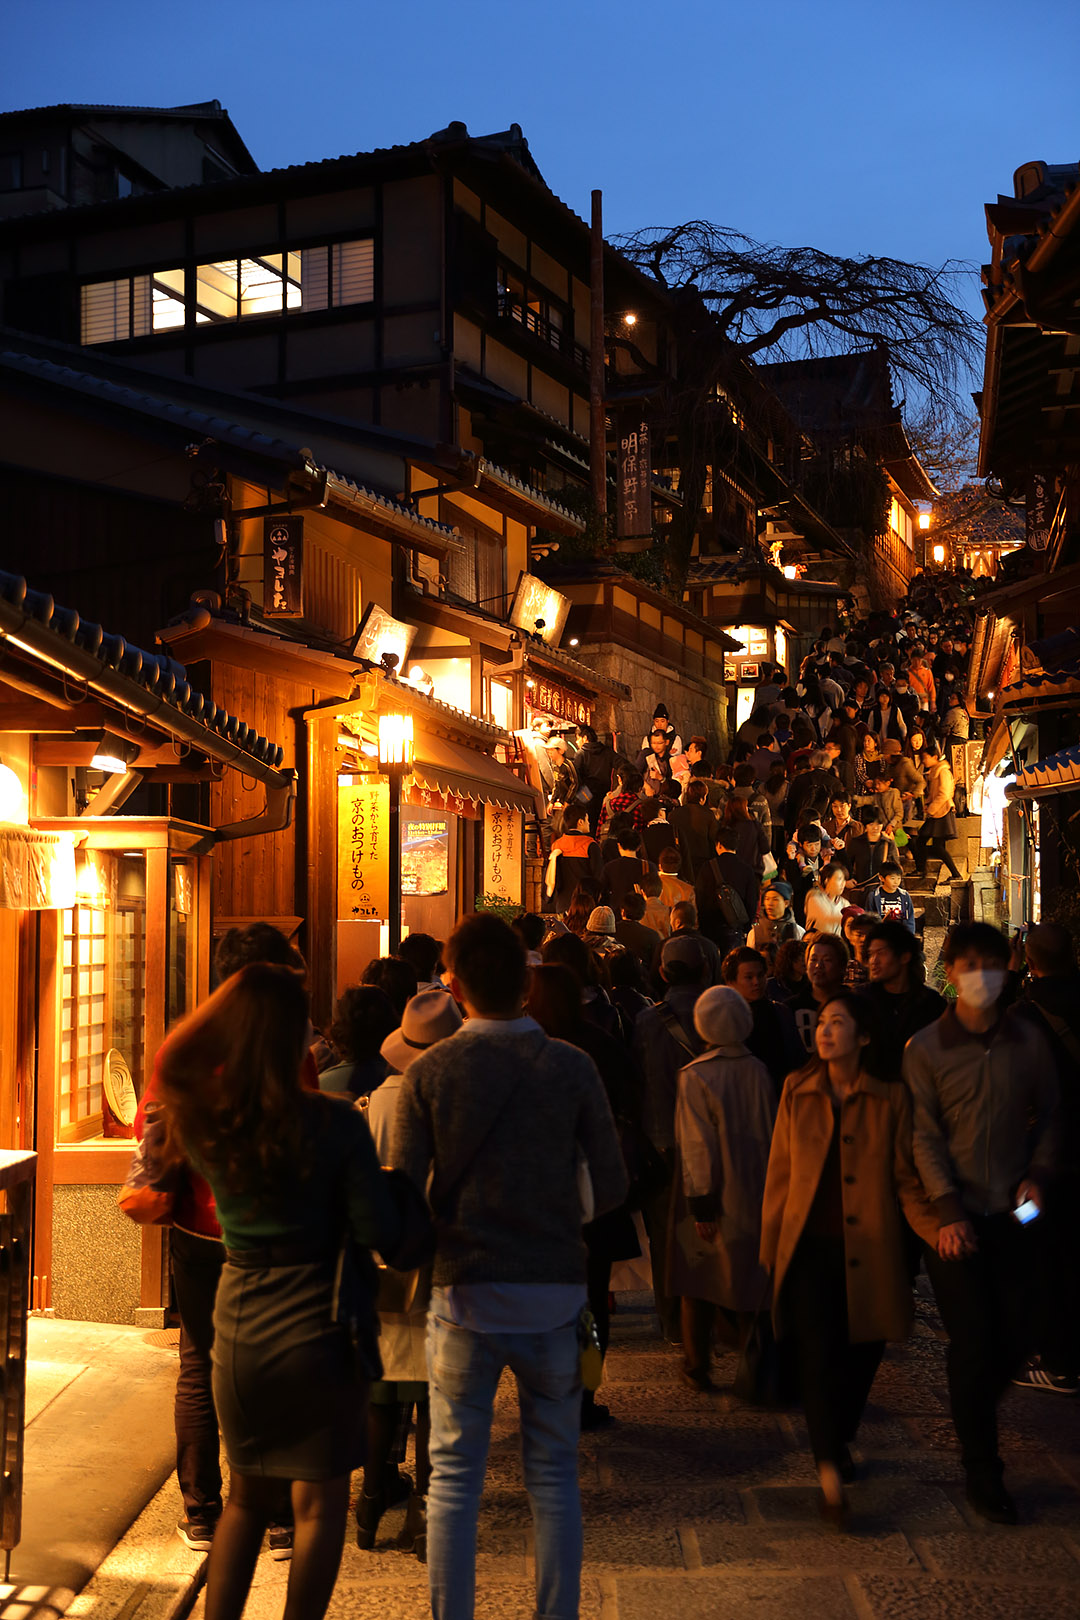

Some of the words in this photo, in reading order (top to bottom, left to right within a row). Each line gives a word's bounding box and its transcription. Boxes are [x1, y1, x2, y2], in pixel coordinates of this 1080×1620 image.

[620, 431, 639, 521] 明保野亭
[351, 797, 365, 891] 京のおつけもの
[369, 791, 380, 860] 野菜から育てた
[491, 812, 503, 884] 京のおつけもの
